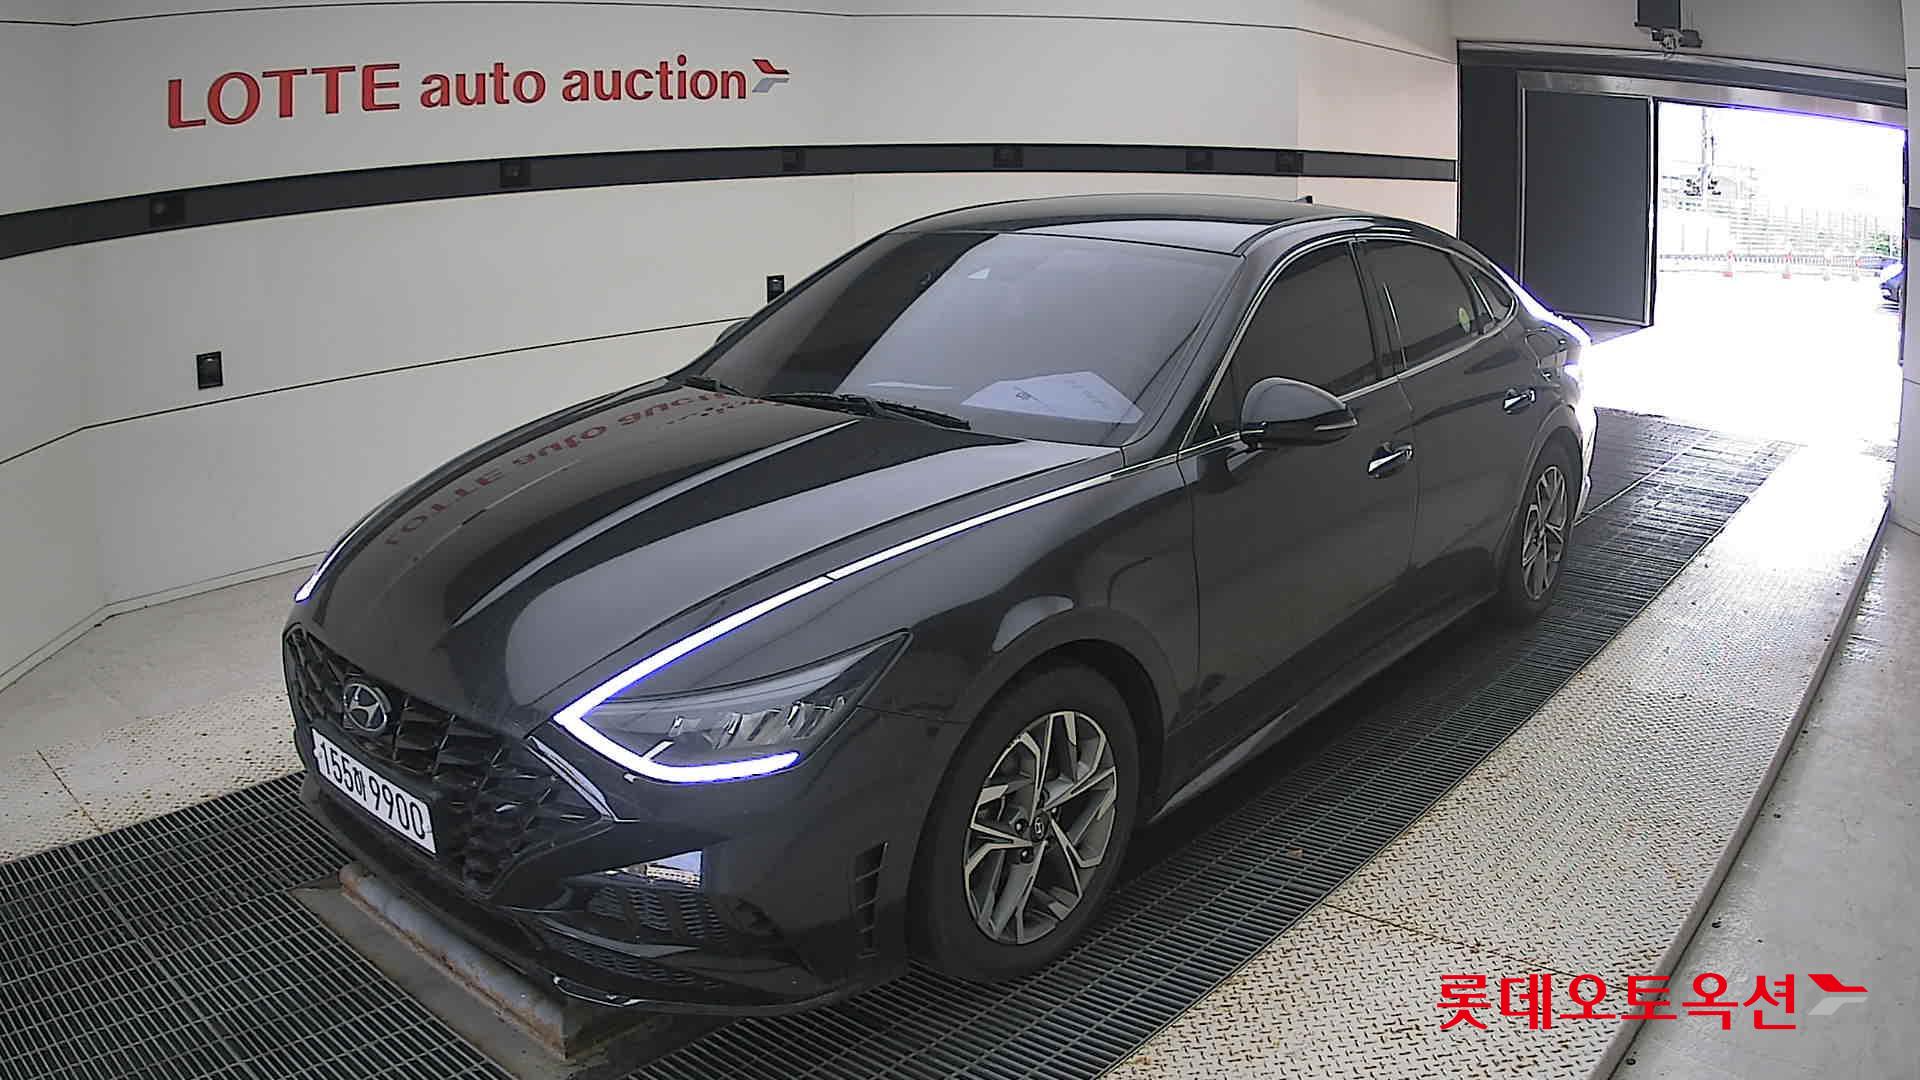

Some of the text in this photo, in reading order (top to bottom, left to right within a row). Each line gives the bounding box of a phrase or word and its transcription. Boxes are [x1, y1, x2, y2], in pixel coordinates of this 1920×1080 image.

[167, 54, 749, 129] LOTTE auto auction
